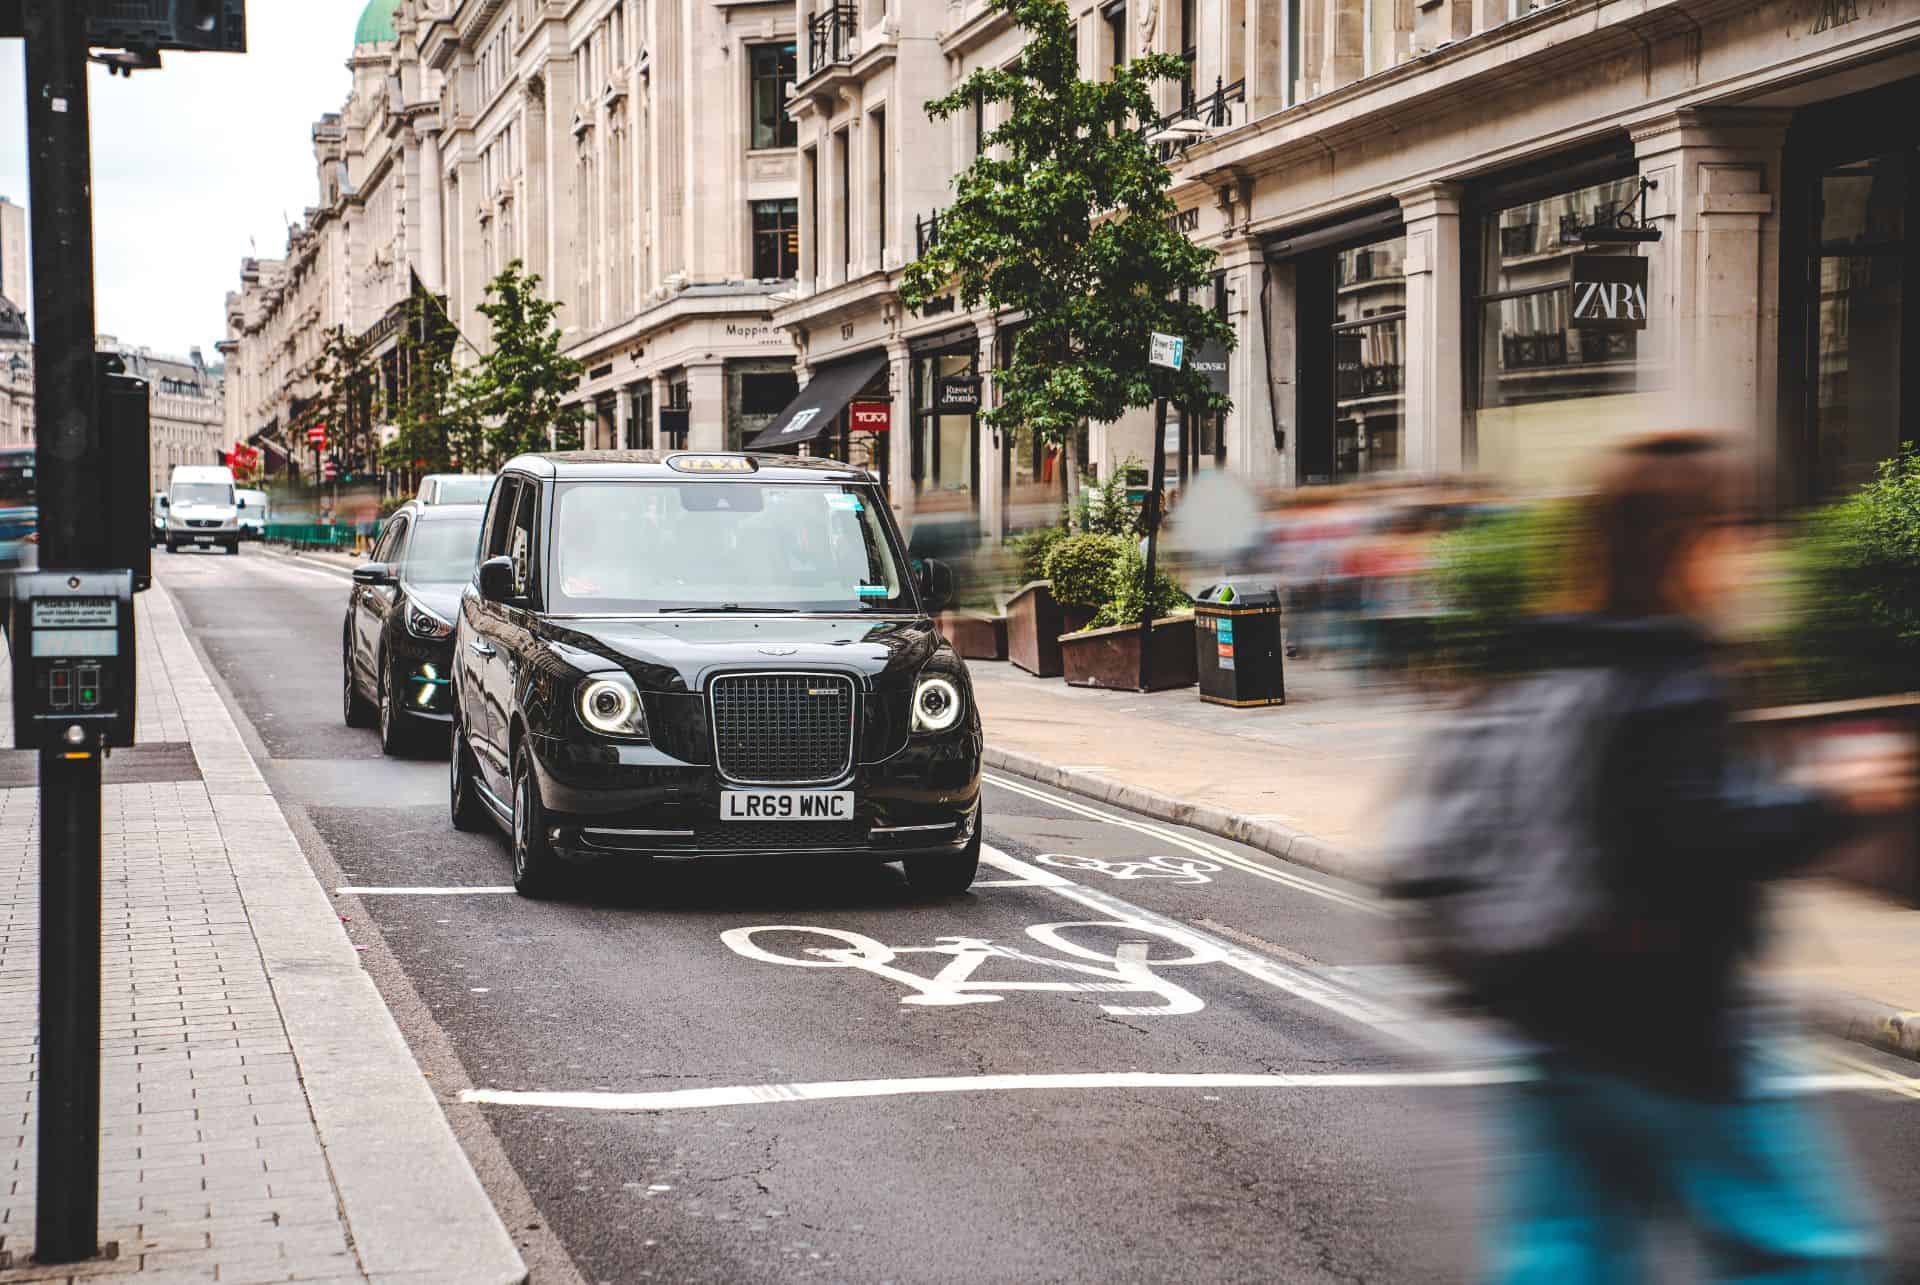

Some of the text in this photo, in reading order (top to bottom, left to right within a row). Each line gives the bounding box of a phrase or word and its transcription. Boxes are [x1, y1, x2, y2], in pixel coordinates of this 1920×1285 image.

[1574, 282, 1646, 320] ZARA
[726, 324, 768, 339] Mappin
[687, 458, 747, 471] TAXI
[730, 795, 844, 816] LR69 WNC
